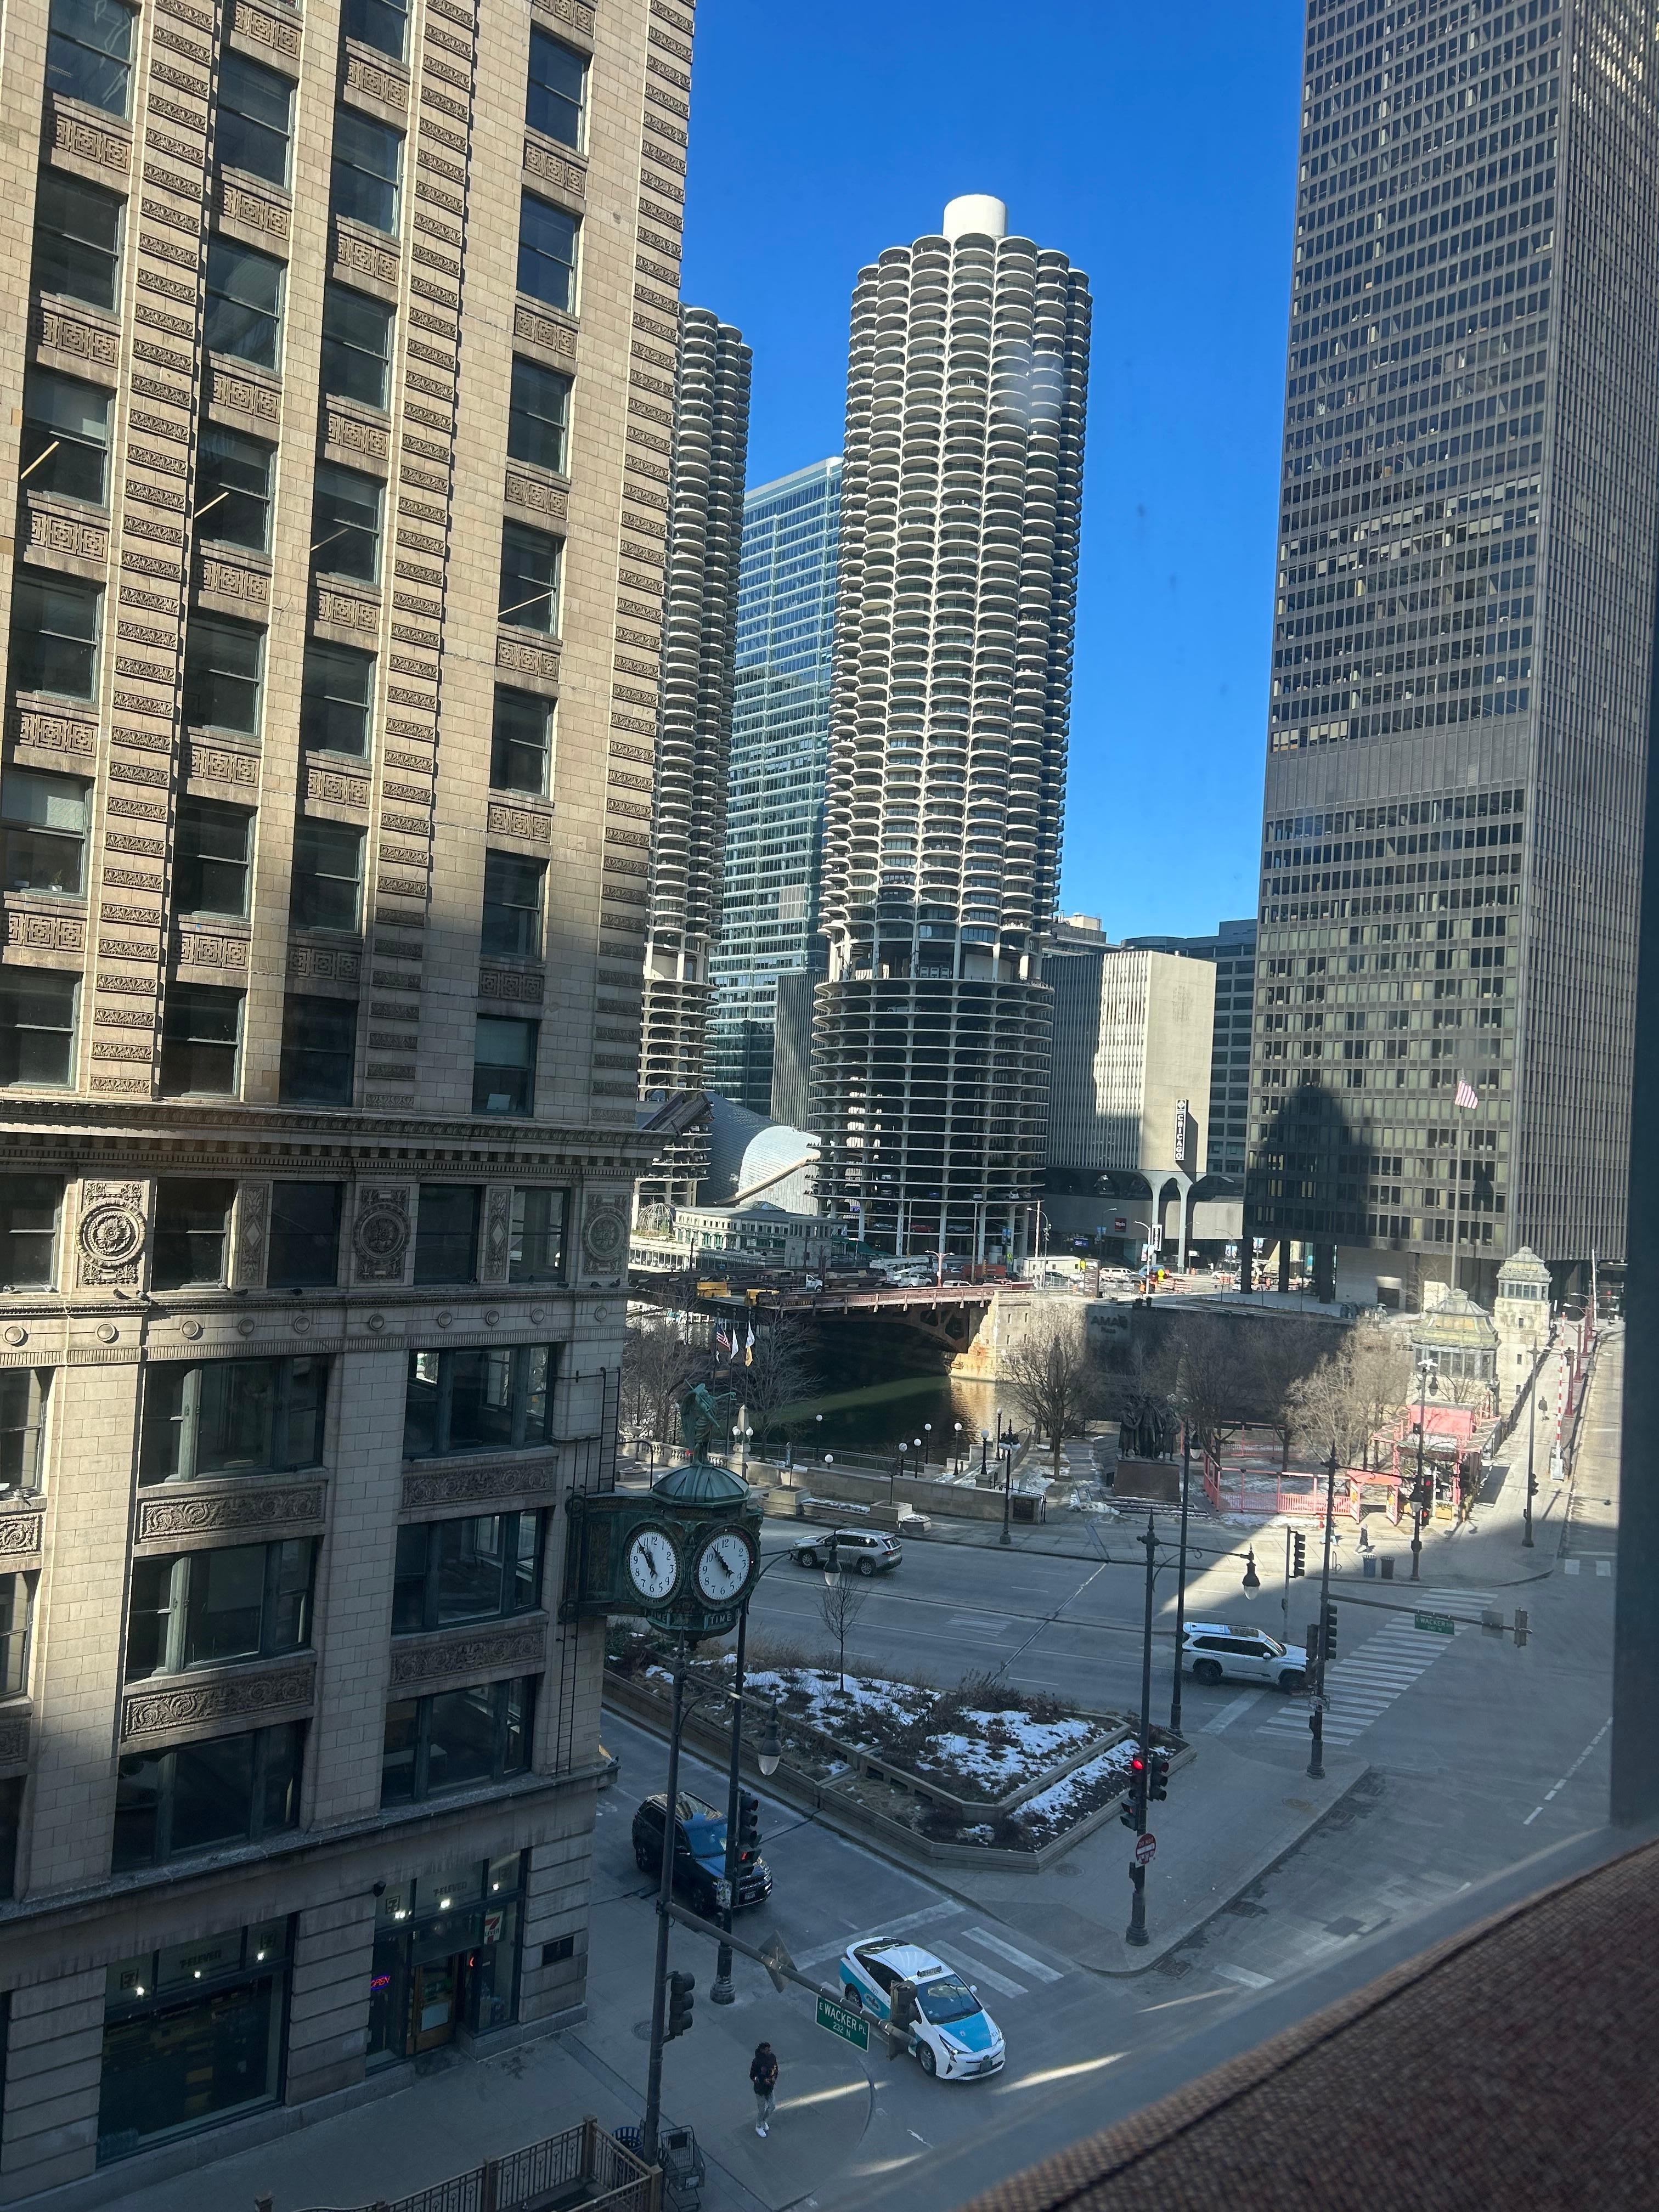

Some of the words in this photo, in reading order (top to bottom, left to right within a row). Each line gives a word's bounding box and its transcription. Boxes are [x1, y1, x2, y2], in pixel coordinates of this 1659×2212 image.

[1176, 1114, 1184, 1159] CHICAGO
[644, 1537, 648, 1547] 11
[651, 1536, 658, 1545] 12
[721, 1538, 729, 1548] 12
[733, 1541, 736, 1549] 1
[662, 1541, 664, 1550] 1
[667, 1551, 672, 1560] 2
[738, 1548, 743, 1557] 2
[633, 1556, 639, 1564] 9
[706, 1553, 713, 1563] 10
[742, 1559, 746, 1569] 3
[635, 1568, 640, 1576] 8
[669, 1565, 674, 1573] 3
[702, 1565, 708, 1575] 9
[665, 1577, 670, 1585] 4
[704, 1577, 710, 1585] 8
[736, 1572, 742, 1581] 4
[641, 1579, 646, 1587] 7
[658, 1582, 663, 1592] 5
[730, 1581, 735, 1591] 5
[650, 1584, 654, 1593] 6
[711, 1585, 716, 1594] 7
[720, 1586, 725, 1595] 6
[710, 1613, 732, 1624] TIME
[1420, 1618, 1445, 1627] WACKER
[819, 2002, 823, 2011] E
[825, 2004, 856, 2031] WACKER
[859, 2024, 866, 2035] PL
[833, 2022, 844, 2033] 232
[847, 2030, 850, 2038] N
